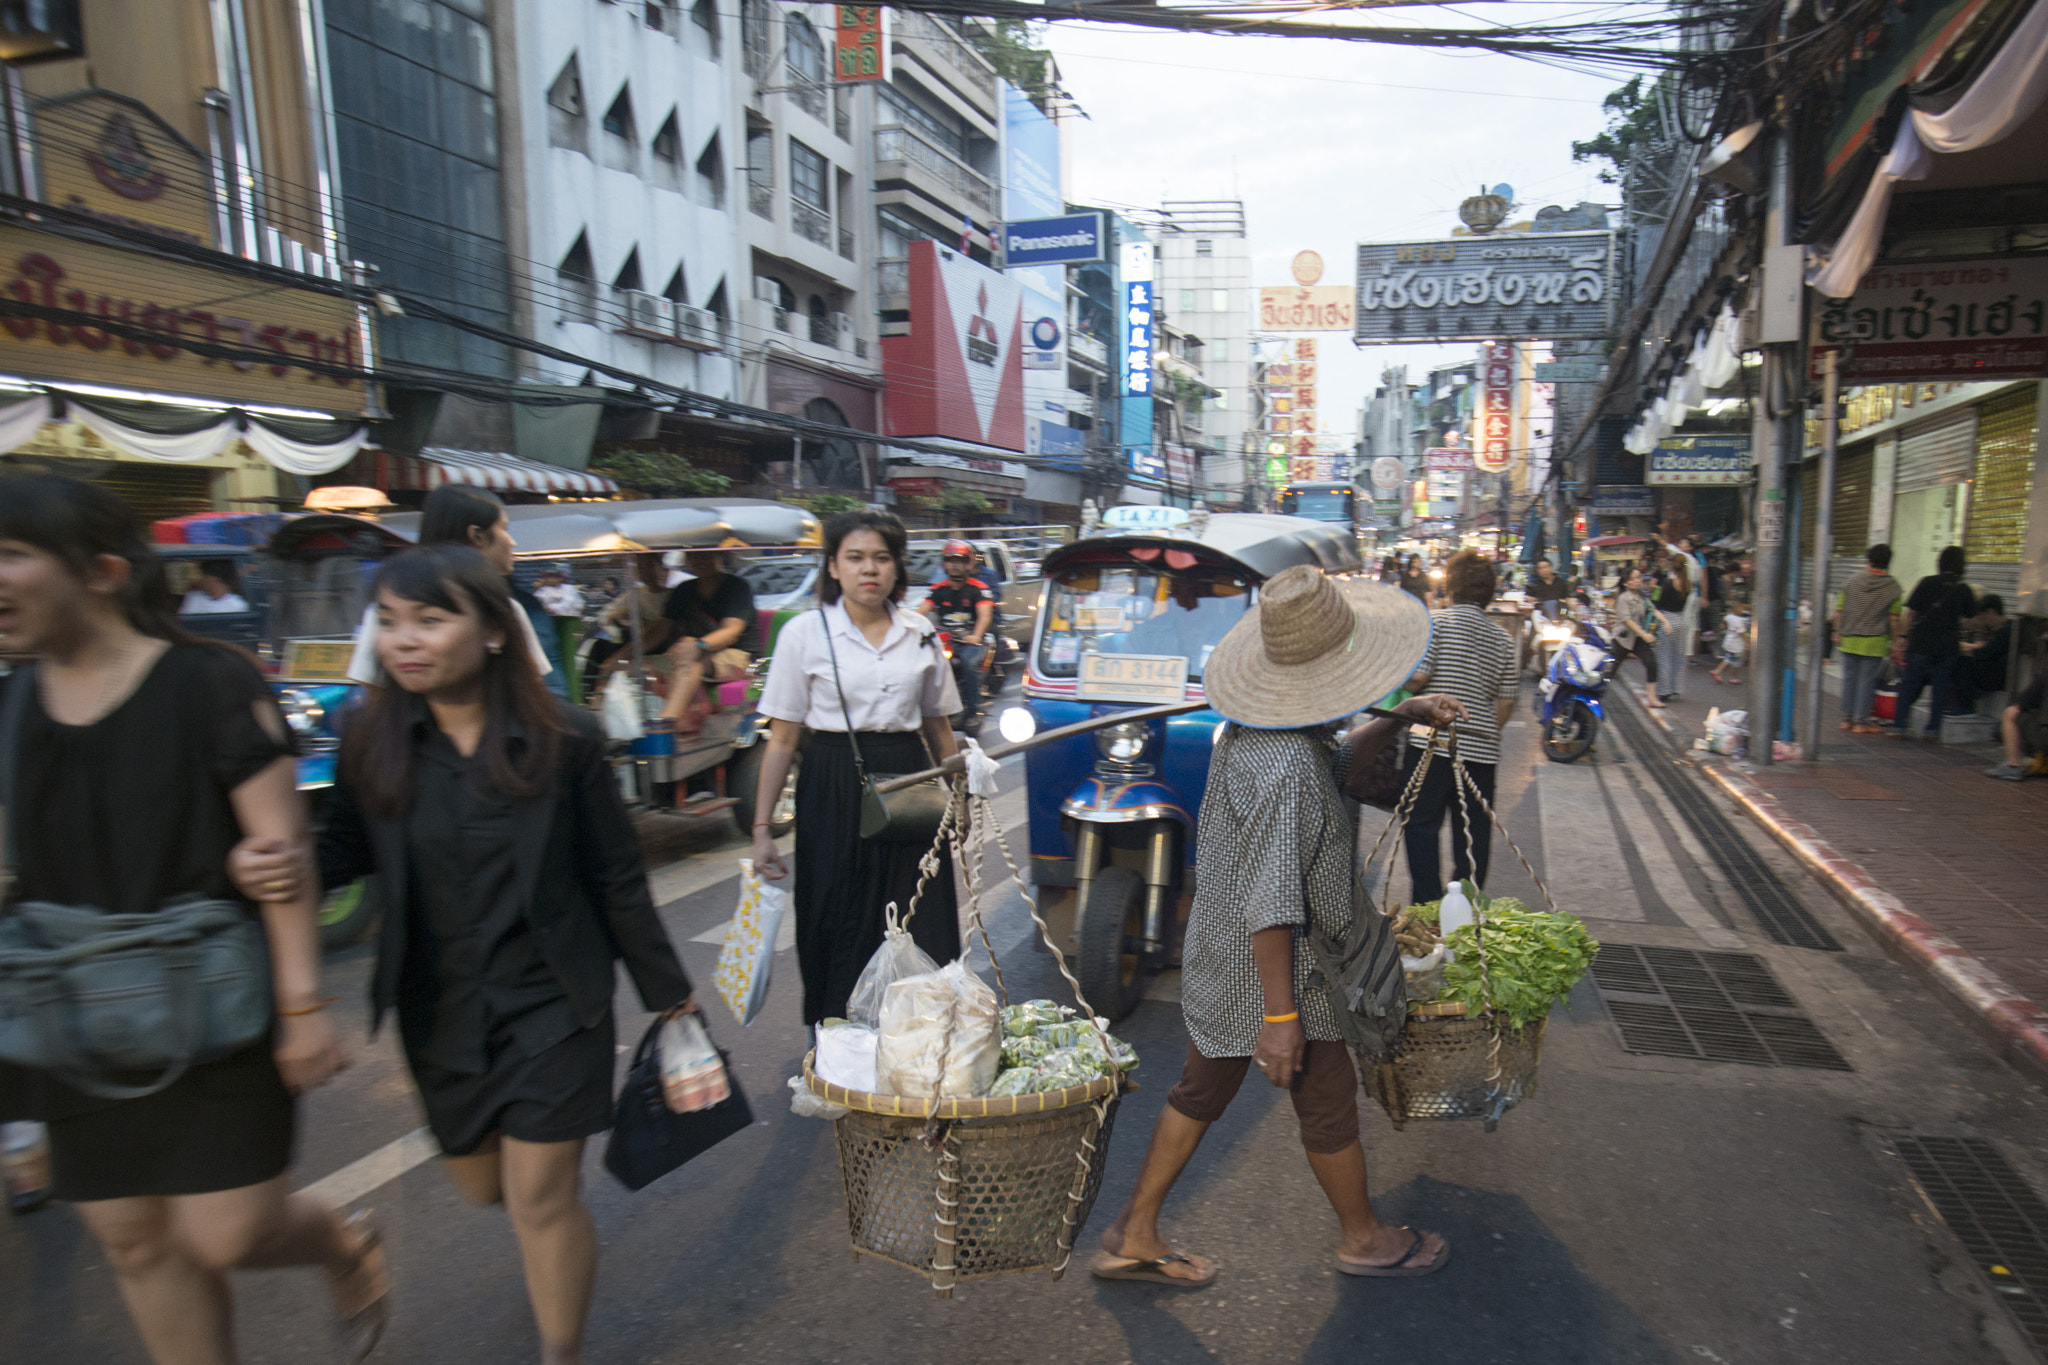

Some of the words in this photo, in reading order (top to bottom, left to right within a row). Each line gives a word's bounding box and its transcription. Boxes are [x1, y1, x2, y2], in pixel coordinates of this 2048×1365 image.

[1008, 230, 1095, 252] Panasonic
[1119, 509, 1169, 522] TAXI
[1131, 661, 1179, 681] 3144
